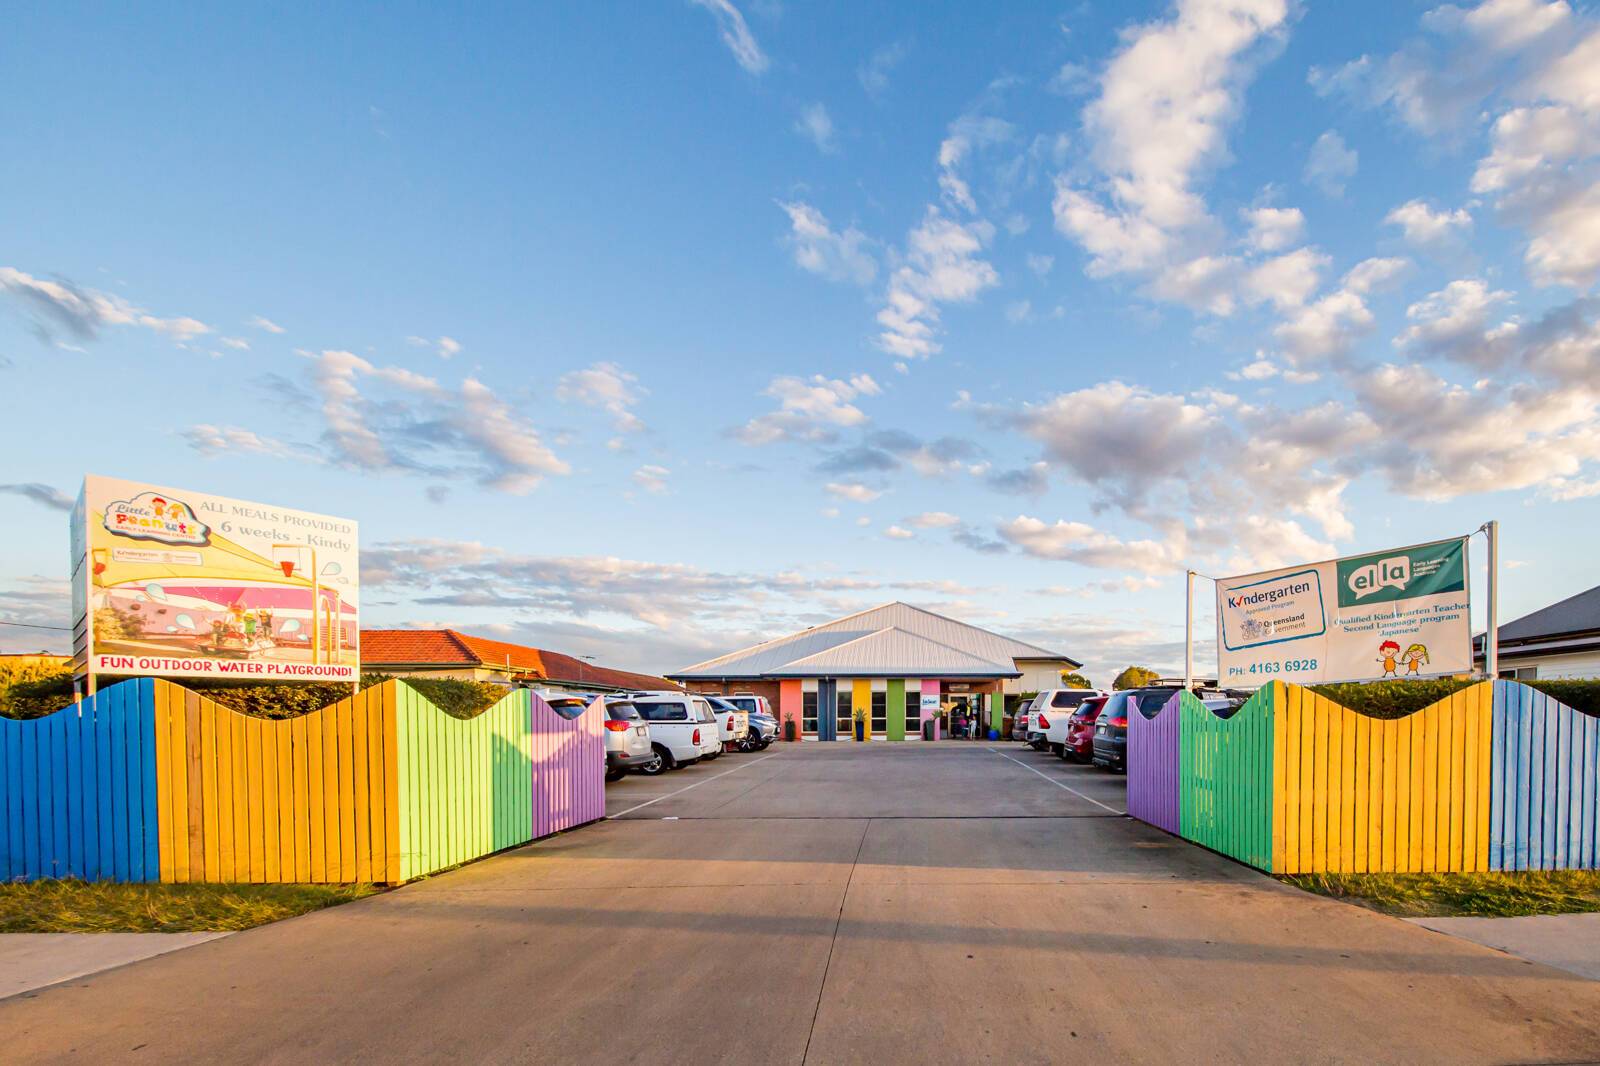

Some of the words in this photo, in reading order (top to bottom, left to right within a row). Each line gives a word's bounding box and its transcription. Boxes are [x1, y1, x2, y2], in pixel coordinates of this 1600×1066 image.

[115, 504, 150, 516] Little
[200, 501, 228, 514] ALL
[232, 506, 279, 522] MEALS
[284, 515, 351, 534] PROVIDED
[116, 514, 195, 535] Peanuts
[221, 521, 232, 533] 6
[239, 527, 290, 541] weeks
[307, 534, 351, 552] Kindy
[1354, 563, 1405, 589] ella
[1433, 603, 1471, 613] Teacher
[1264, 621, 1306, 635] Gvernment
[1343, 624, 1374, 633] Second
[1376, 617, 1416, 629] Language
[1420, 613, 1460, 625] program
[100, 656, 134, 669] FUN
[139, 658, 213, 672] OUTDOOR
[218, 661, 263, 674] WATER
[267, 663, 352, 677] PLAYGROUND!
[1229, 667, 1246, 676] PH:
[1249, 662, 1280, 674] 4163
[1285, 659, 1318, 672] 6928
